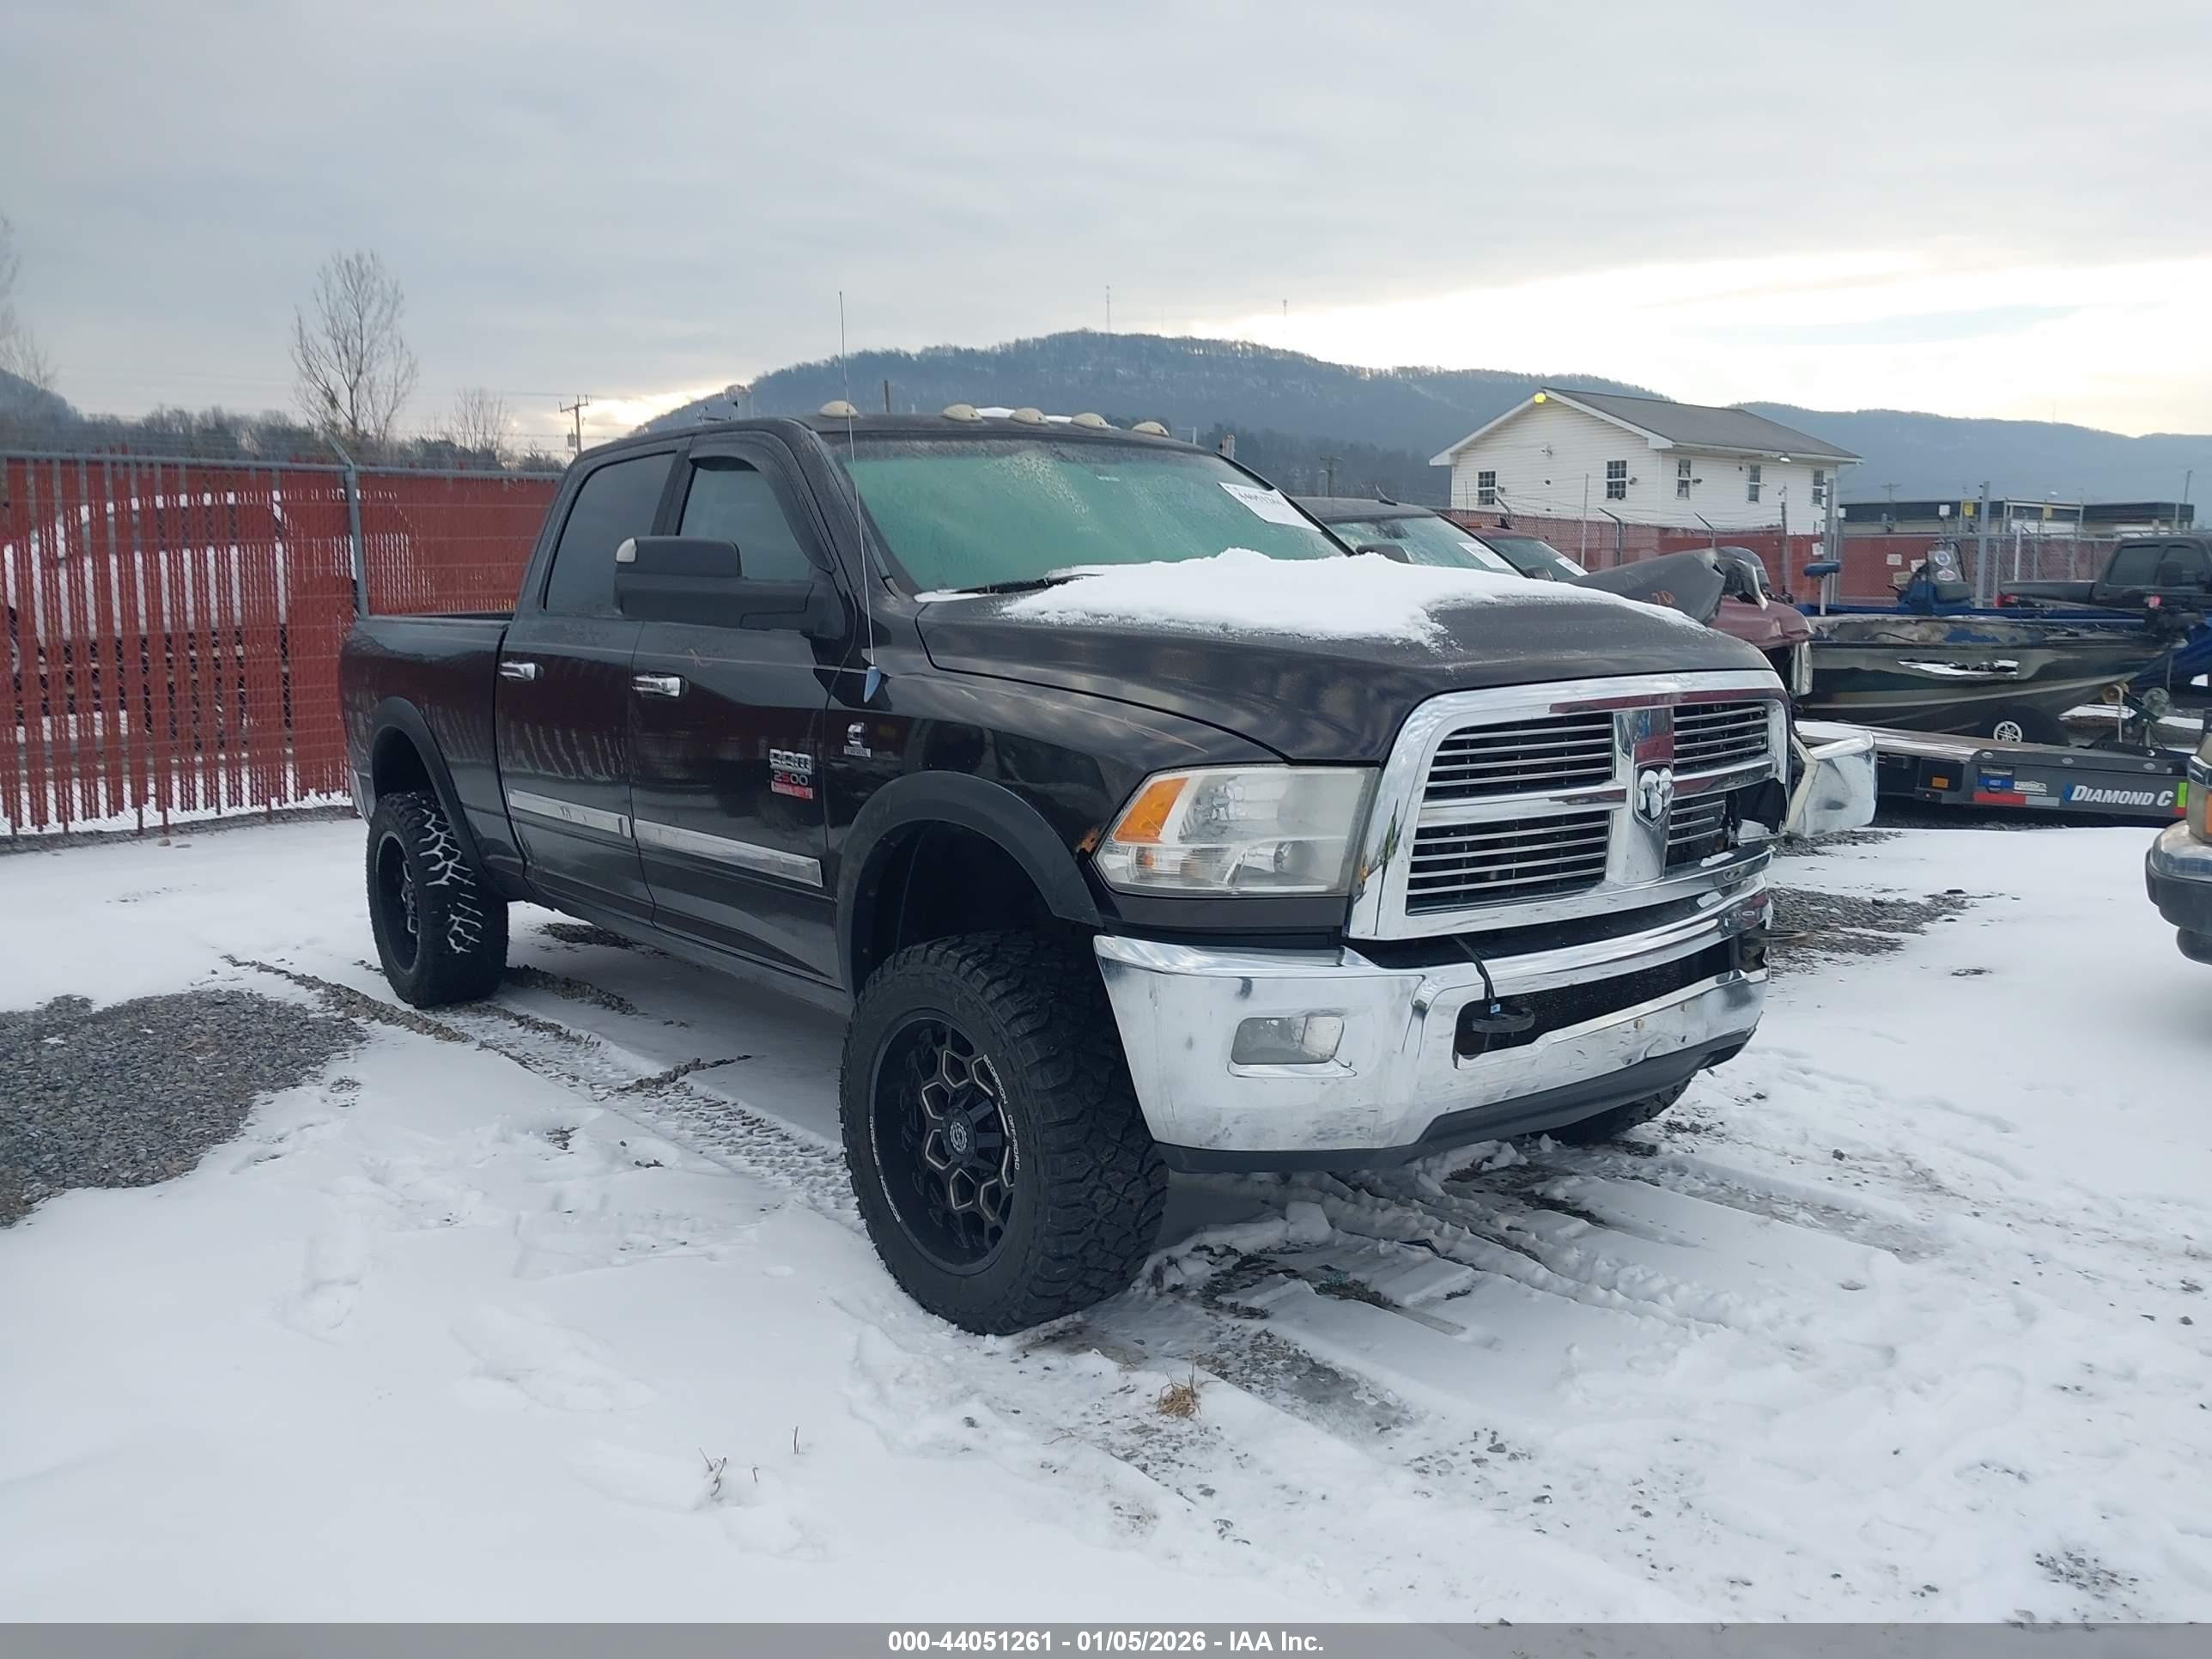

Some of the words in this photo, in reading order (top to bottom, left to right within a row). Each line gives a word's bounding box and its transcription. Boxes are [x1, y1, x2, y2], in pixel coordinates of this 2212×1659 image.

[774, 769, 809, 786] 2500
[2070, 785, 2154, 805] DIAMOND
[2156, 791, 2174, 806] C
[982, 1053, 1009, 1105] SCORPION
